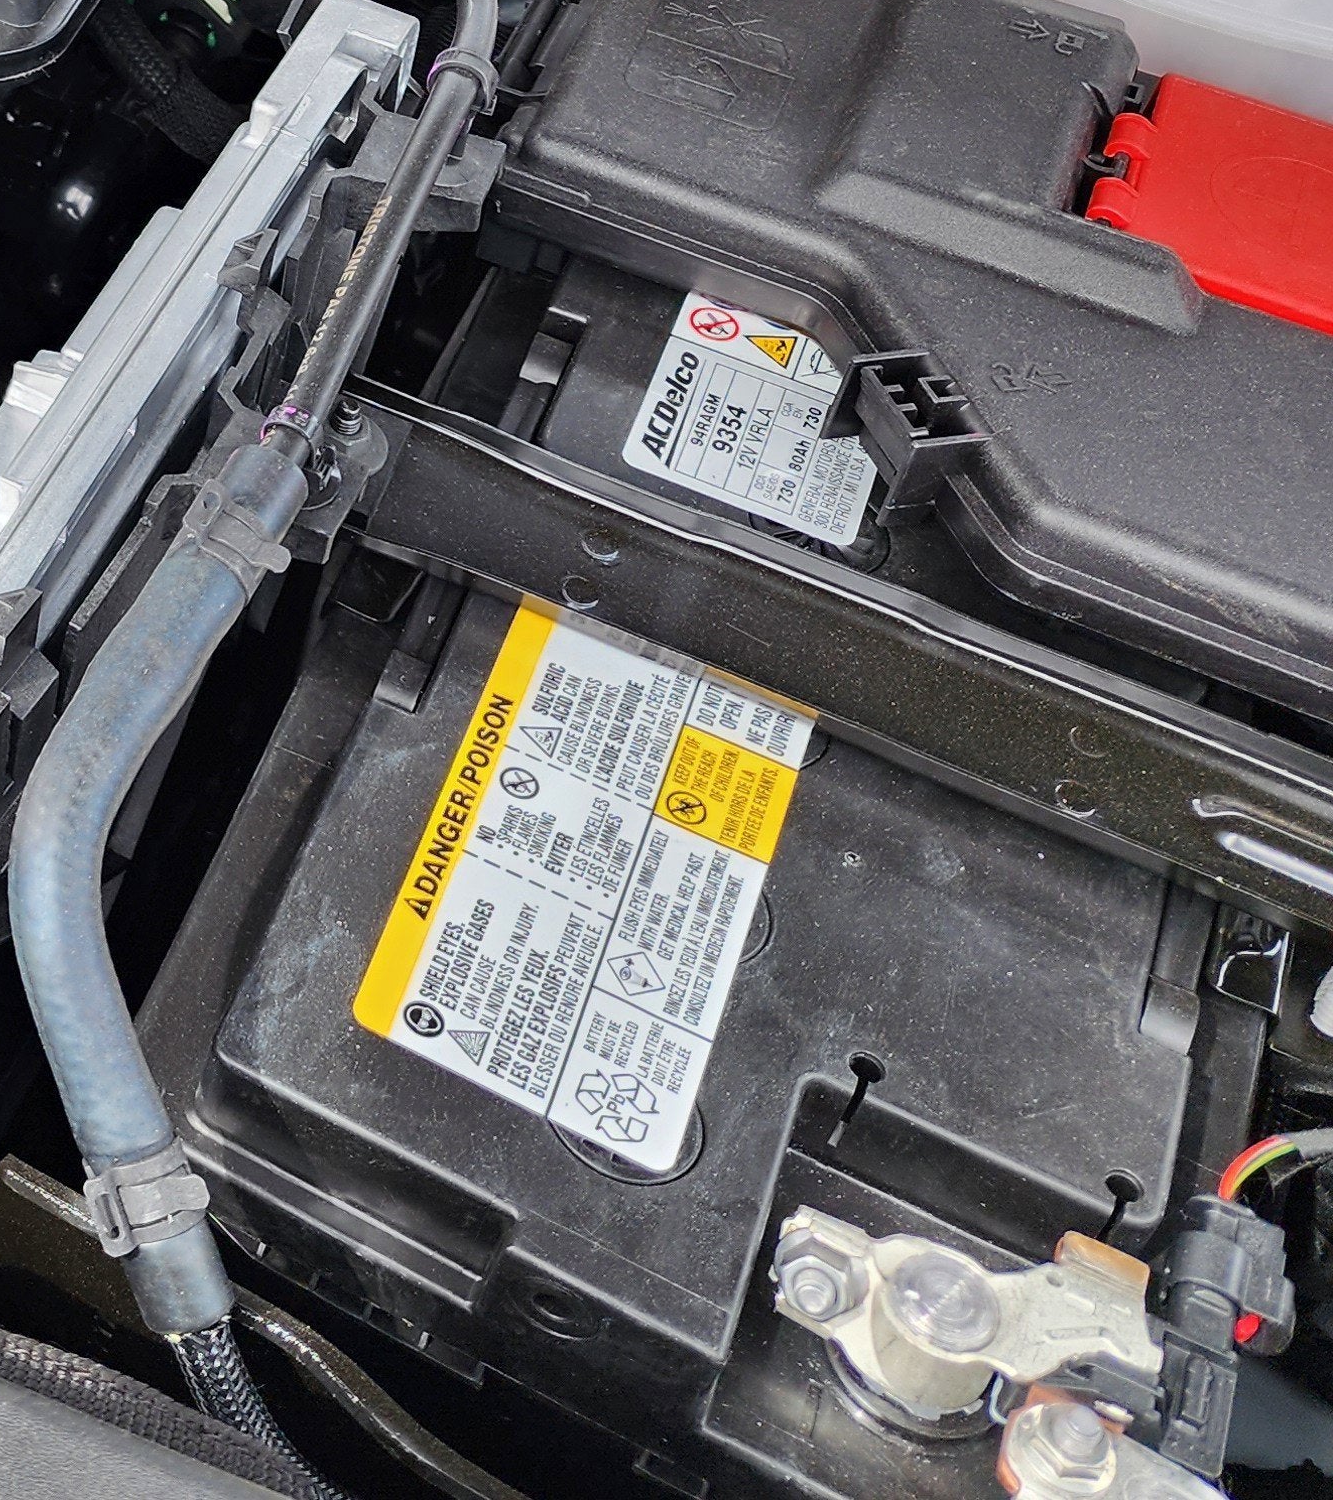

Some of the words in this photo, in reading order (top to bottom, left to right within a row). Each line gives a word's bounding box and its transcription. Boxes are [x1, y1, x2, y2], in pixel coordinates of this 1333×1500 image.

[338, 195, 393, 285] TRISTONE
[641, 351, 699, 459] ACDelco
[689, 392, 722, 447] 94RAGM
[801, 406, 823, 430] 730
[711, 404, 747, 454] 9354
[745, 407, 775, 443] VRLA
[737, 445, 759, 470] 12V
[787, 439, 812, 472] 80Ah
[776, 478, 797, 504] 730
[797, 481, 824, 523] GENERAL
[813, 441, 837, 479] MOTORS
[819, 448, 852, 511] RENAISSANCE
[842, 479, 859, 495] MI
[813, 509, 832, 529] 300
[829, 493, 857, 535] DETROIT,
[531, 662, 566, 716] SULFURIC
[561, 673, 583, 698] CAN
[594, 683, 622, 721] BURNS.
[643, 672, 671, 711] CÉCITÉ
[701, 683, 725, 710] NOT
[549, 694, 574, 725] ACID
[568, 676, 603, 734] BLINDNESS
[606, 679, 645, 745] SULFURIQUE
[639, 708, 659, 726] LA
[695, 706, 717, 727] DO
[718, 698, 745, 731] OPEN.
[749, 706, 773, 731] PAS
[556, 730, 582, 766] CAUSE
[580, 717, 608, 759] SEVERE
[625, 722, 653, 766] CAUSER
[647, 707, 680, 764] BRÛLURES
[684, 734, 701, 750] OF
[744, 726, 767, 747] NE
[574, 756, 594, 774] OR
[592, 741, 622, 784] L'ACIDE
[678, 745, 697, 767] OUT
[695, 748, 718, 779] REACH
[712, 748, 740, 792] CHILDREN.
[614, 762, 639, 793] PEUT
[639, 761, 661, 785] DES
[671, 762, 691, 787] KEEP
[689, 774, 709, 795] THE
[734, 779, 753, 796] DE
[738, 768, 757, 783] LA
[752, 767, 779, 808] ENFANTS.
[413, 693, 513, 896] DANGER/POISON
[633, 781, 653, 801] OU
[708, 787, 726, 803] OF
[727, 792, 749, 819] HORS
[495, 804, 523, 844] SPARKS
[575, 796, 611, 857] ÉTINCELLES
[747, 803, 767, 821] DE
[475, 824, 497, 845] NO
[511, 810, 539, 852] FLAMES
[527, 811, 557, 858] SMOKING
[592, 812, 623, 865] FLAMMES
[718, 815, 741, 843] TENIR
[539, 831, 574, 876] ÉVITER
[567, 854, 589, 878] LES
[606, 837, 634, 878] FUMER
[636, 829, 669, 889] IMMEDIATELY
[683, 851, 706, 878] FAST.
[584, 862, 606, 886] LES
[600, 874, 621, 894] DE
[675, 874, 696, 902] HELP
[627, 886, 650, 913] EYES
[644, 892, 669, 927] WATER.
[508, 902, 539, 948] INJURY.
[617, 908, 641, 944] FLUSH
[636, 923, 658, 952] WITH
[662, 901, 690, 943] MEDICAL
[437, 938, 479, 1012] EXPLOSIVE
[464, 898, 495, 942] GASES
[502, 944, 523, 965] OR
[553, 911, 585, 967] PEUVENT
[571, 923, 604, 979] AVEUGLE.
[655, 938, 676, 962] GET
[418, 954, 451, 1001] SHIELD
[435, 921, 466, 957] EYES.
[519, 947, 550, 985] YEUX.
[678, 943, 699, 969] YEUX
[468, 953, 497, 995] CAUSE
[672, 966, 692, 988] LES
[458, 991, 483, 1021] CAN
[478, 963, 516, 1030] BLINDNESS
[510, 983, 536, 1013] LES
[526, 963, 567, 1036] EXPLOSIFS
[553, 975, 585, 1026] RENDRE
[661, 982, 687, 1018] RINCEZ
[682, 974, 712, 1027] CONSULTEZ
[697, 960, 717, 979] UN
[486, 1007, 527, 1079] PROTÉGEZ
[547, 1022, 568, 1044] OU
[582, 1010, 607, 1054] BATTERY
[606, 1019, 622, 1035] BE
[639, 1020, 665, 1066] BATTERIE
[516, 1031, 543, 1063] GAZ
[597, 1031, 617, 1062] MUST
[612, 1020, 639, 1069] RECYCLED
[506, 1060, 533, 1090] LES
[527, 1042, 562, 1099] BLESSER
[634, 1064, 651, 1080] LA
[649, 1060, 669, 1087] DOIT
[605, 1093, 626, 1116] Pb
